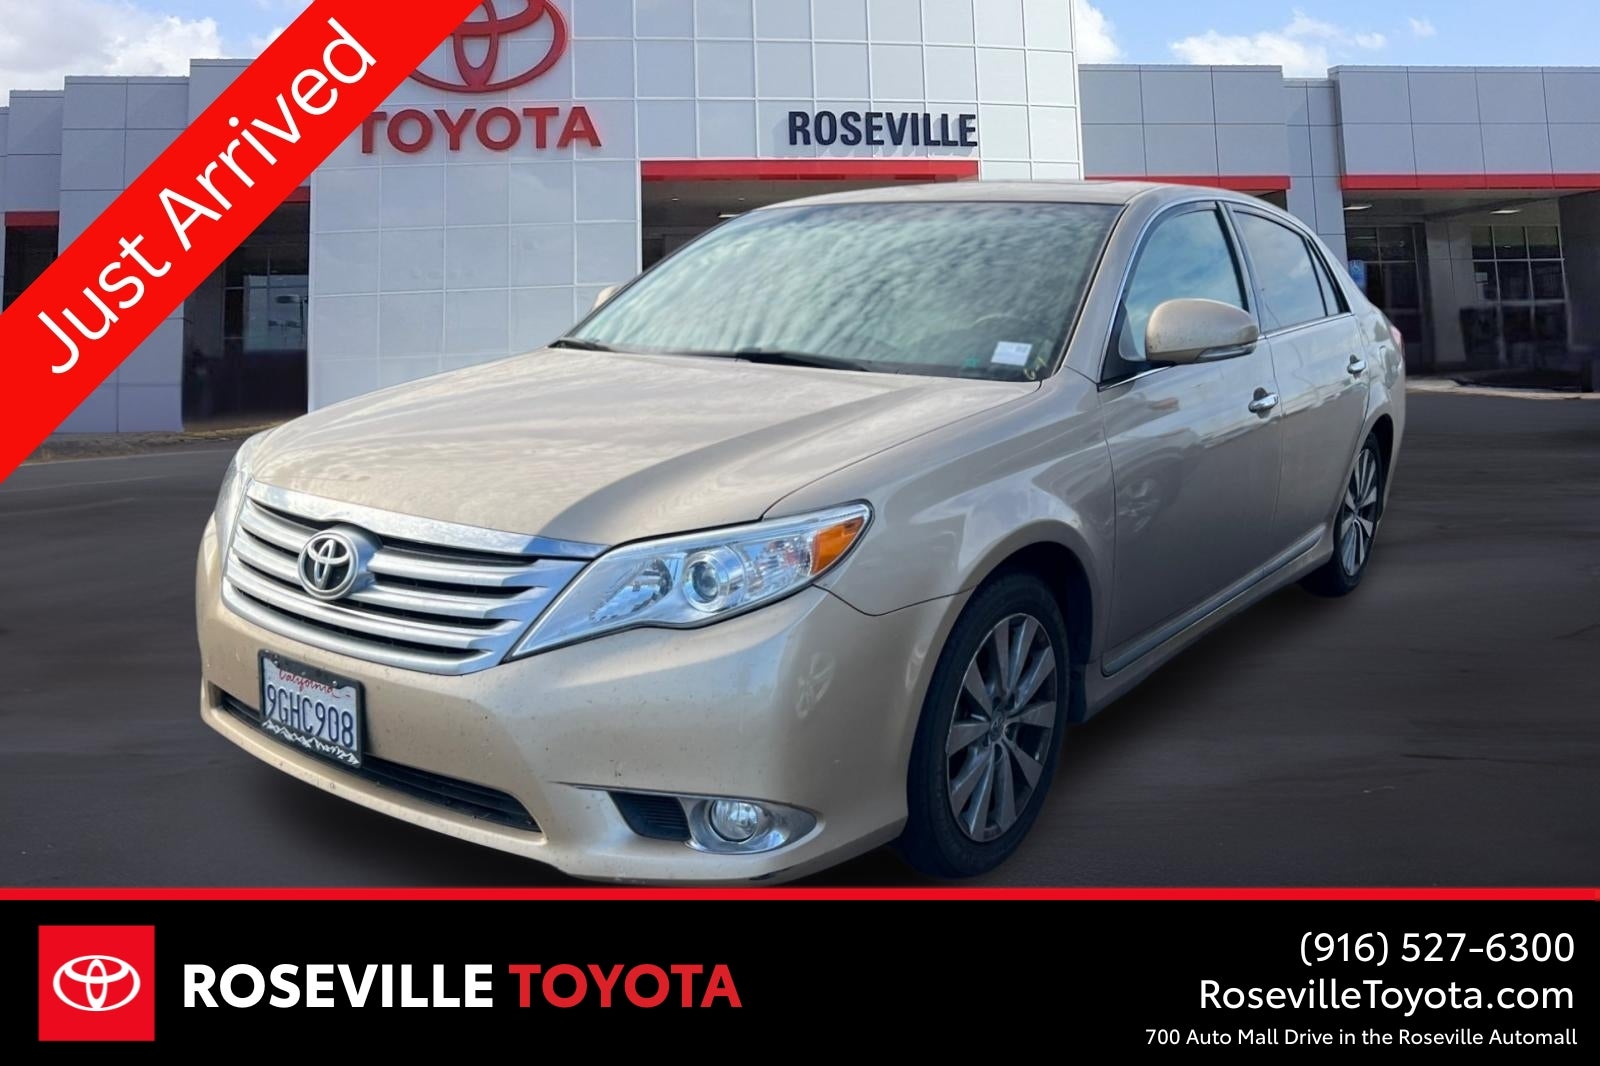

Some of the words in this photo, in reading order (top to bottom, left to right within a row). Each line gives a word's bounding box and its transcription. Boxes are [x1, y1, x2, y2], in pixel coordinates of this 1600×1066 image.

[360, 106, 602, 154] TOYOTA
[788, 110, 978, 147] ROSEVILLE
[266, 684, 354, 749] 9GHC908
